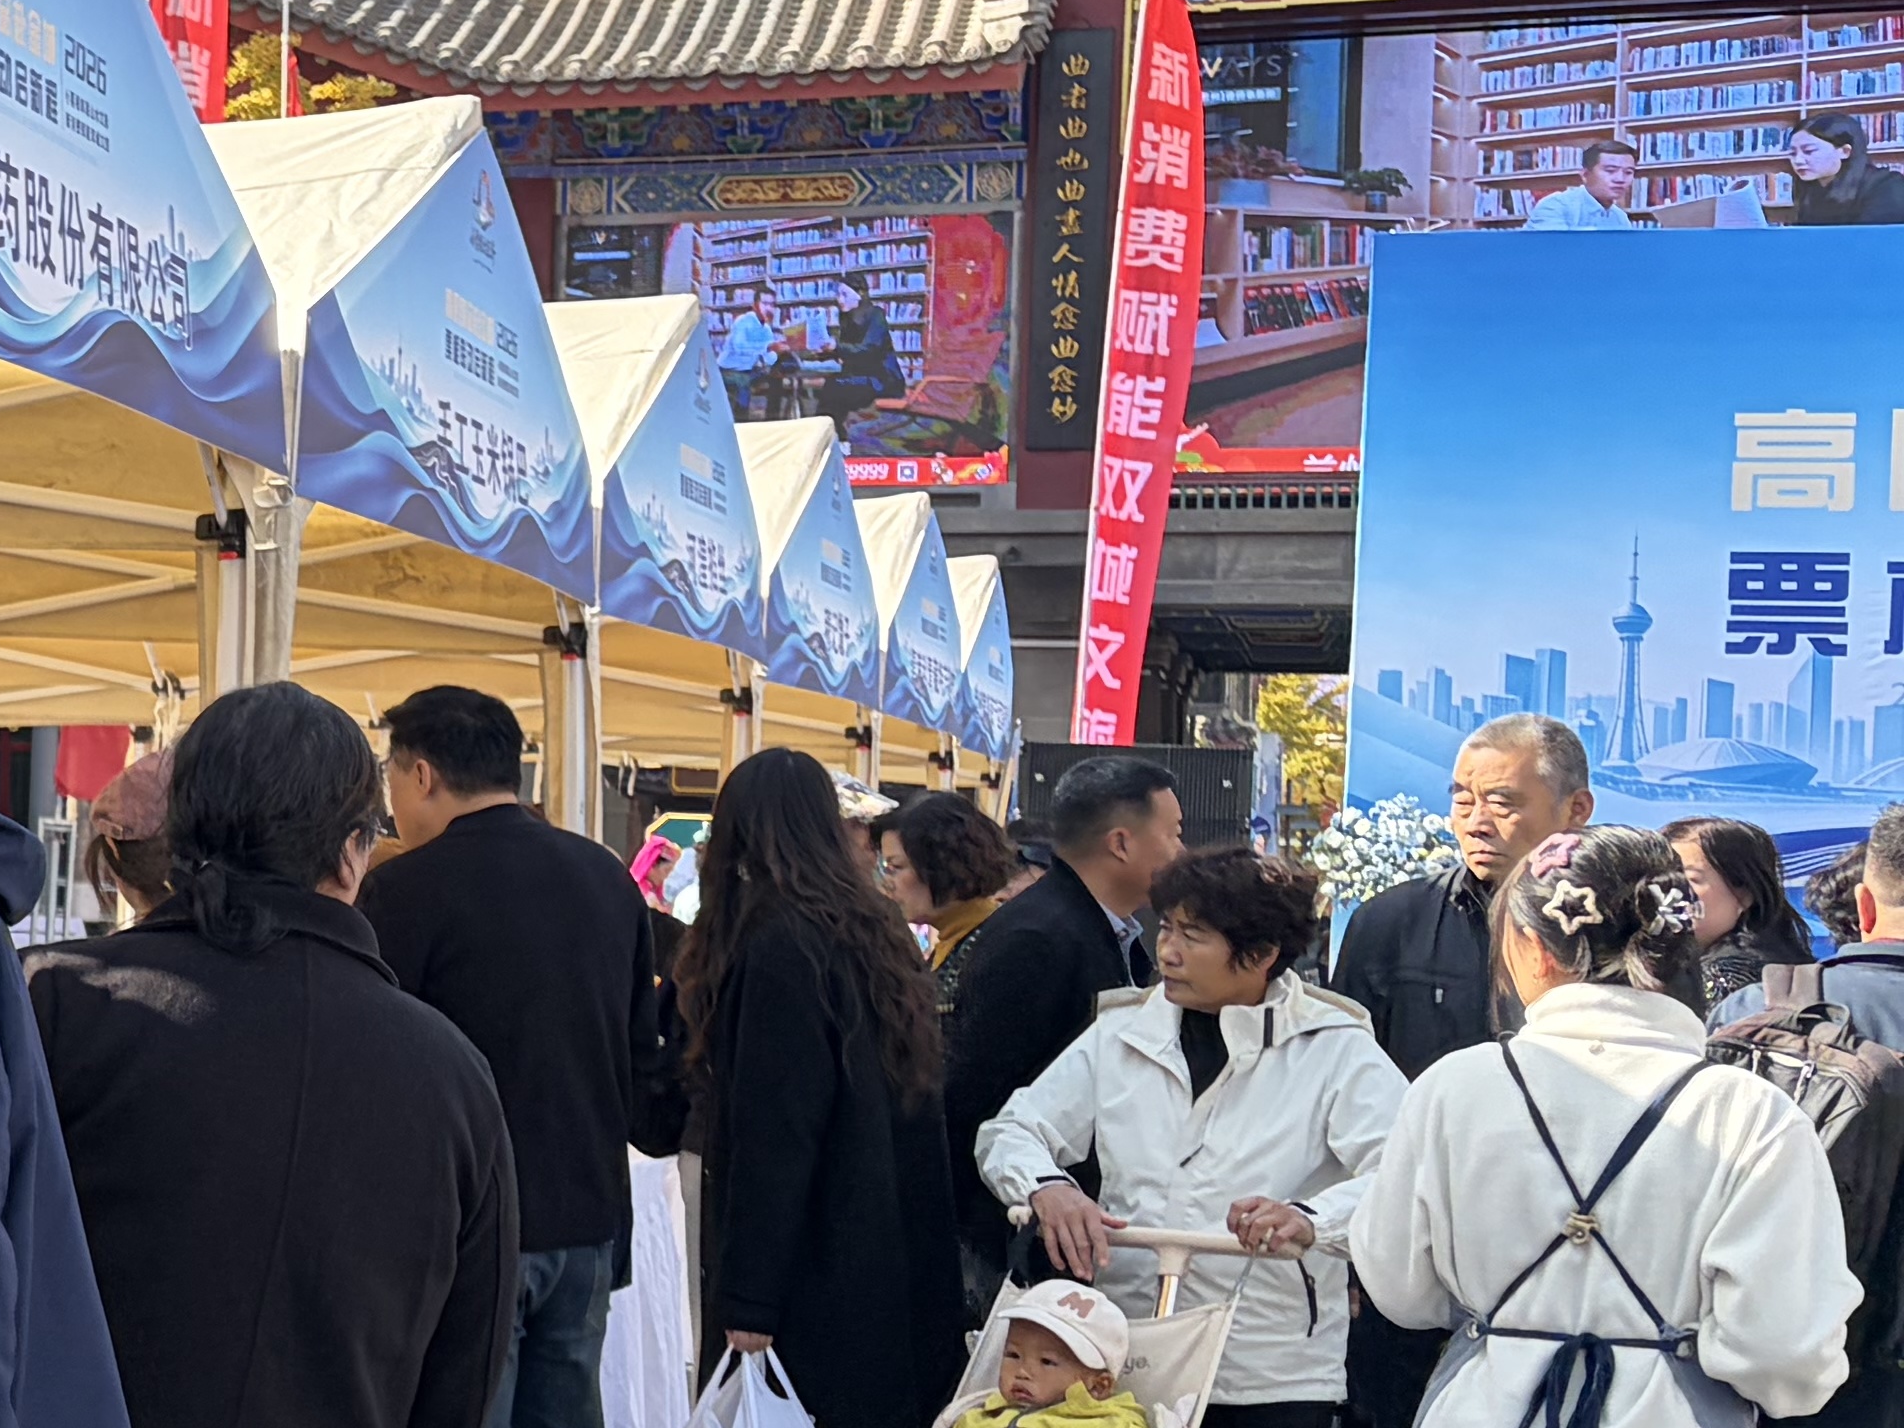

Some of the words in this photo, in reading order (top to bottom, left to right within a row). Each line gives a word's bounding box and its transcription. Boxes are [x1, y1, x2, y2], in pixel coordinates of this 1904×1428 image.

[64, 33, 108, 97] 2026
[1076, 40, 1192, 746] 新消费赋能双城文旅
[1731, 408, 1904, 512] 高
[1724, 551, 1904, 657] 票
[1057, 1291, 1096, 1320] M
